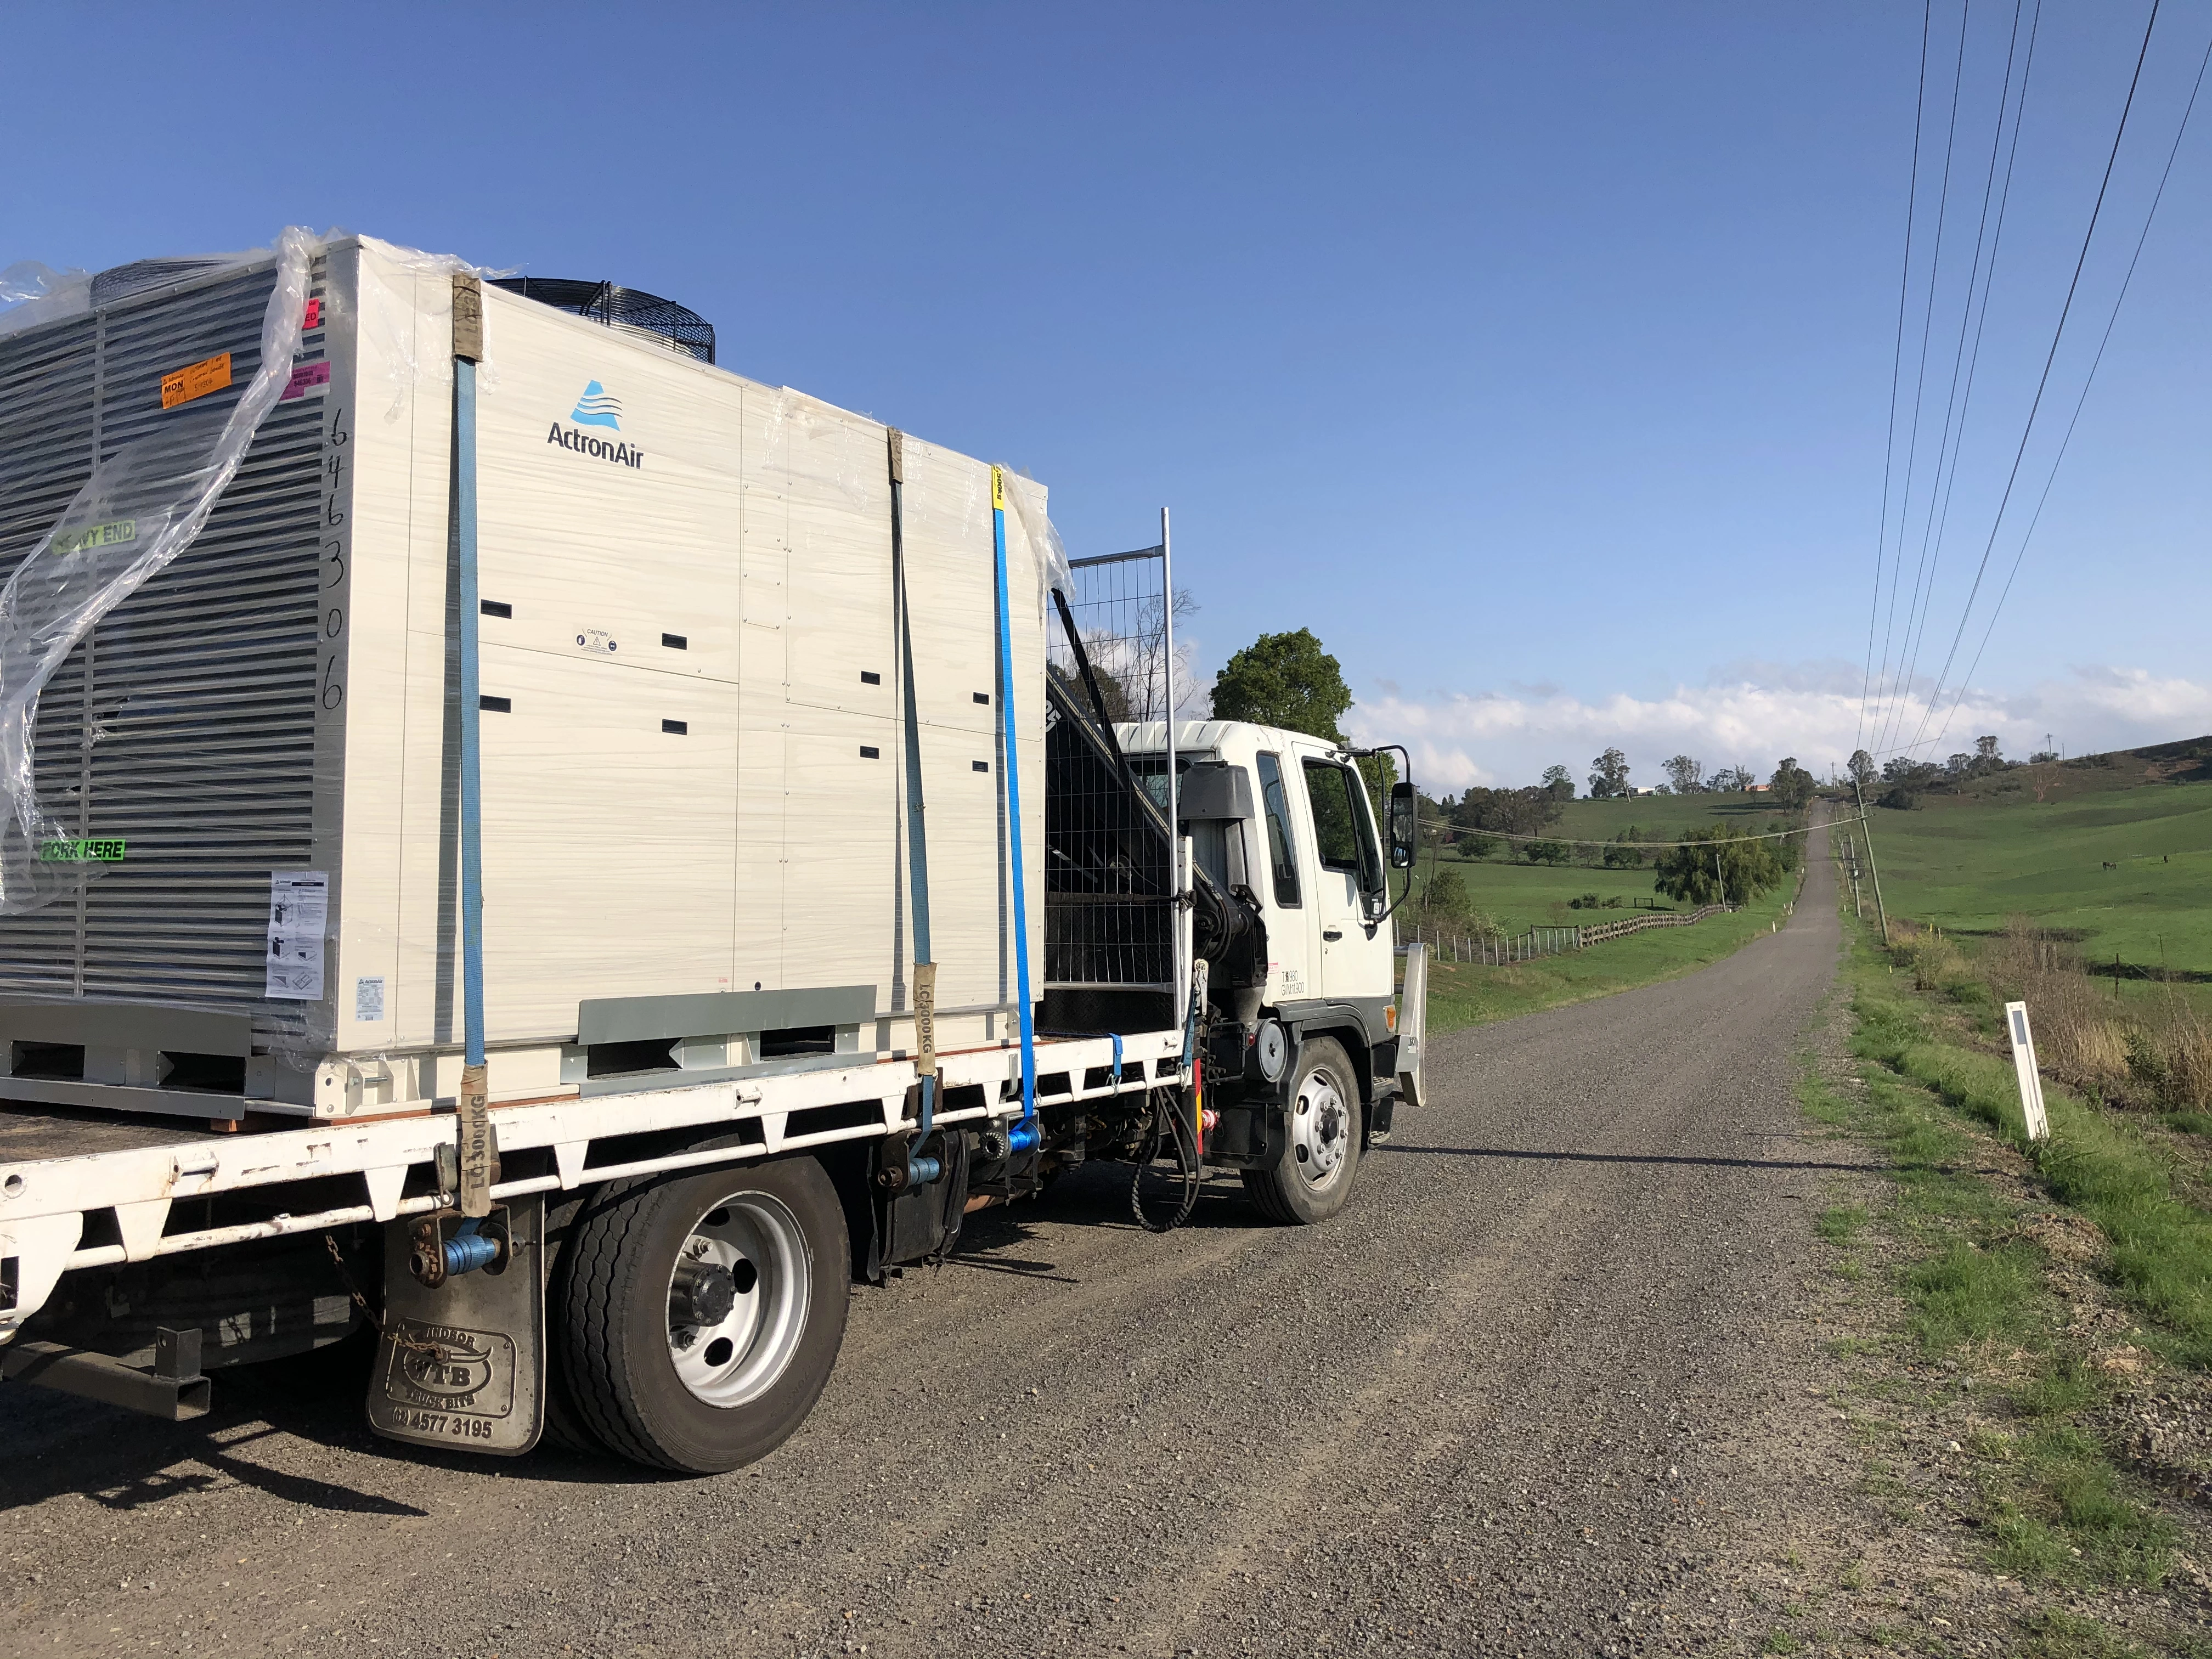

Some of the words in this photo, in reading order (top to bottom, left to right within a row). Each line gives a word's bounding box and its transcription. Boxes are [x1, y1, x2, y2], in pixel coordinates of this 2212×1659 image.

[165, 380, 184, 394] MON
[547, 422, 644, 470] ActronAir
[104, 522, 133, 543] END
[587, 628, 608, 637] CAUTION
[42, 842, 80, 858] FORK
[83, 841, 123, 858] HERE
[445, 1394, 476, 1409] BITS
[411, 1412, 450, 1432] 4577
[451, 1417, 494, 1439] 3195
